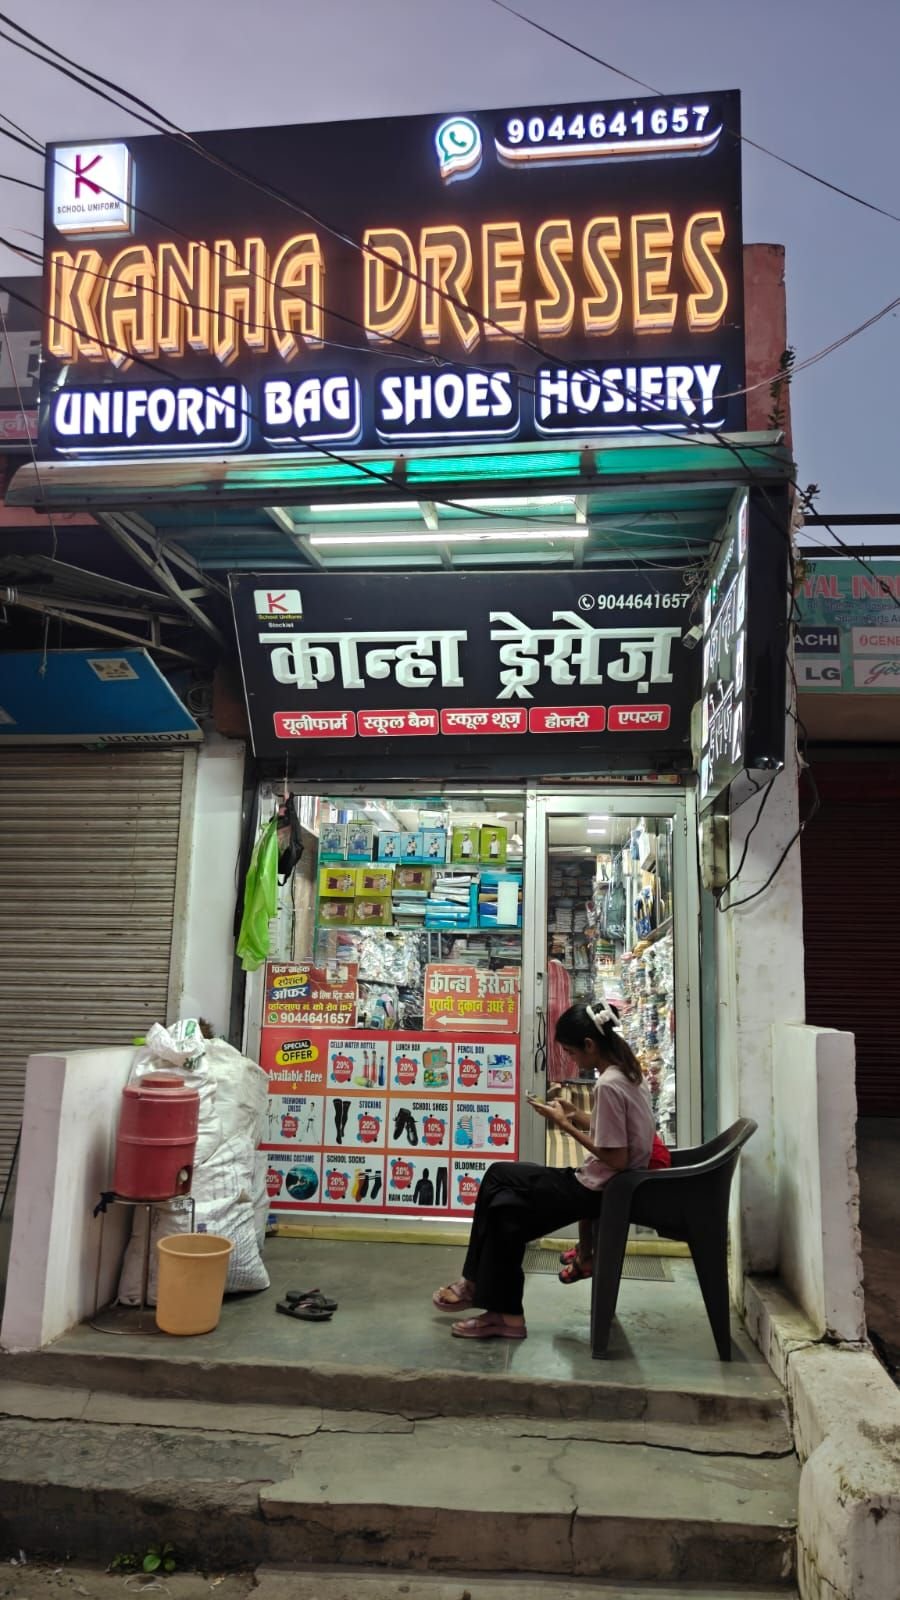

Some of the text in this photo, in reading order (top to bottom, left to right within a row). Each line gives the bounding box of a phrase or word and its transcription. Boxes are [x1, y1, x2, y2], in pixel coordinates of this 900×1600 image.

[507, 105, 710, 144] 9044641657
[75, 154, 103, 199] K
[57, 201, 121, 214] SCHOOL UNIFORM
[48, 210, 730, 369] KANHA DRESSES
[54, 364, 723, 438] UNIFORM BAG SHOES HOSIERY
[267, 592, 289, 613] K
[598, 594, 690, 610] 9044641657
[258, 630, 468, 690] कान्हा
[489, 611, 682, 700] ड्रेसेज़
[805, 667, 841, 681] LG
[282, 714, 348, 736] यूनीफार्म
[363, 716, 405, 734] स्कूल
[408, 712, 435, 728] बैग
[446, 713, 489, 730] स्कूल
[544, 712, 590, 729] होजरी
[617, 711, 663, 725] एपरन
[99, 733, 189, 742] LUCKNOW
[457, 999, 483, 1017] दुकान
[280, 1012, 352, 1024] 9044641657
[283, 1041, 310, 1050] SPECIAL
[282, 1050, 313, 1062] OFFER
[336, 1061, 350, 1069] 20%
[400, 1063, 414, 1072] 20%
[462, 1064, 477, 1073] 20%
[268, 1069, 323, 1082] Available Here
[412, 1102, 432, 1111] SCHOOL
[456, 1104, 490, 1113] SCHOOL BAGS
[362, 1121, 377, 1130] 20%
[427, 1123, 442, 1132] 10%
[493, 1124, 507, 1132] 10%
[326, 1154, 366, 1164] SCHOOL SOCKS
[454, 1162, 486, 1171] BLOOMERS
[330, 1177, 345, 1186] 20%
[462, 1182, 477, 1191] 20%
